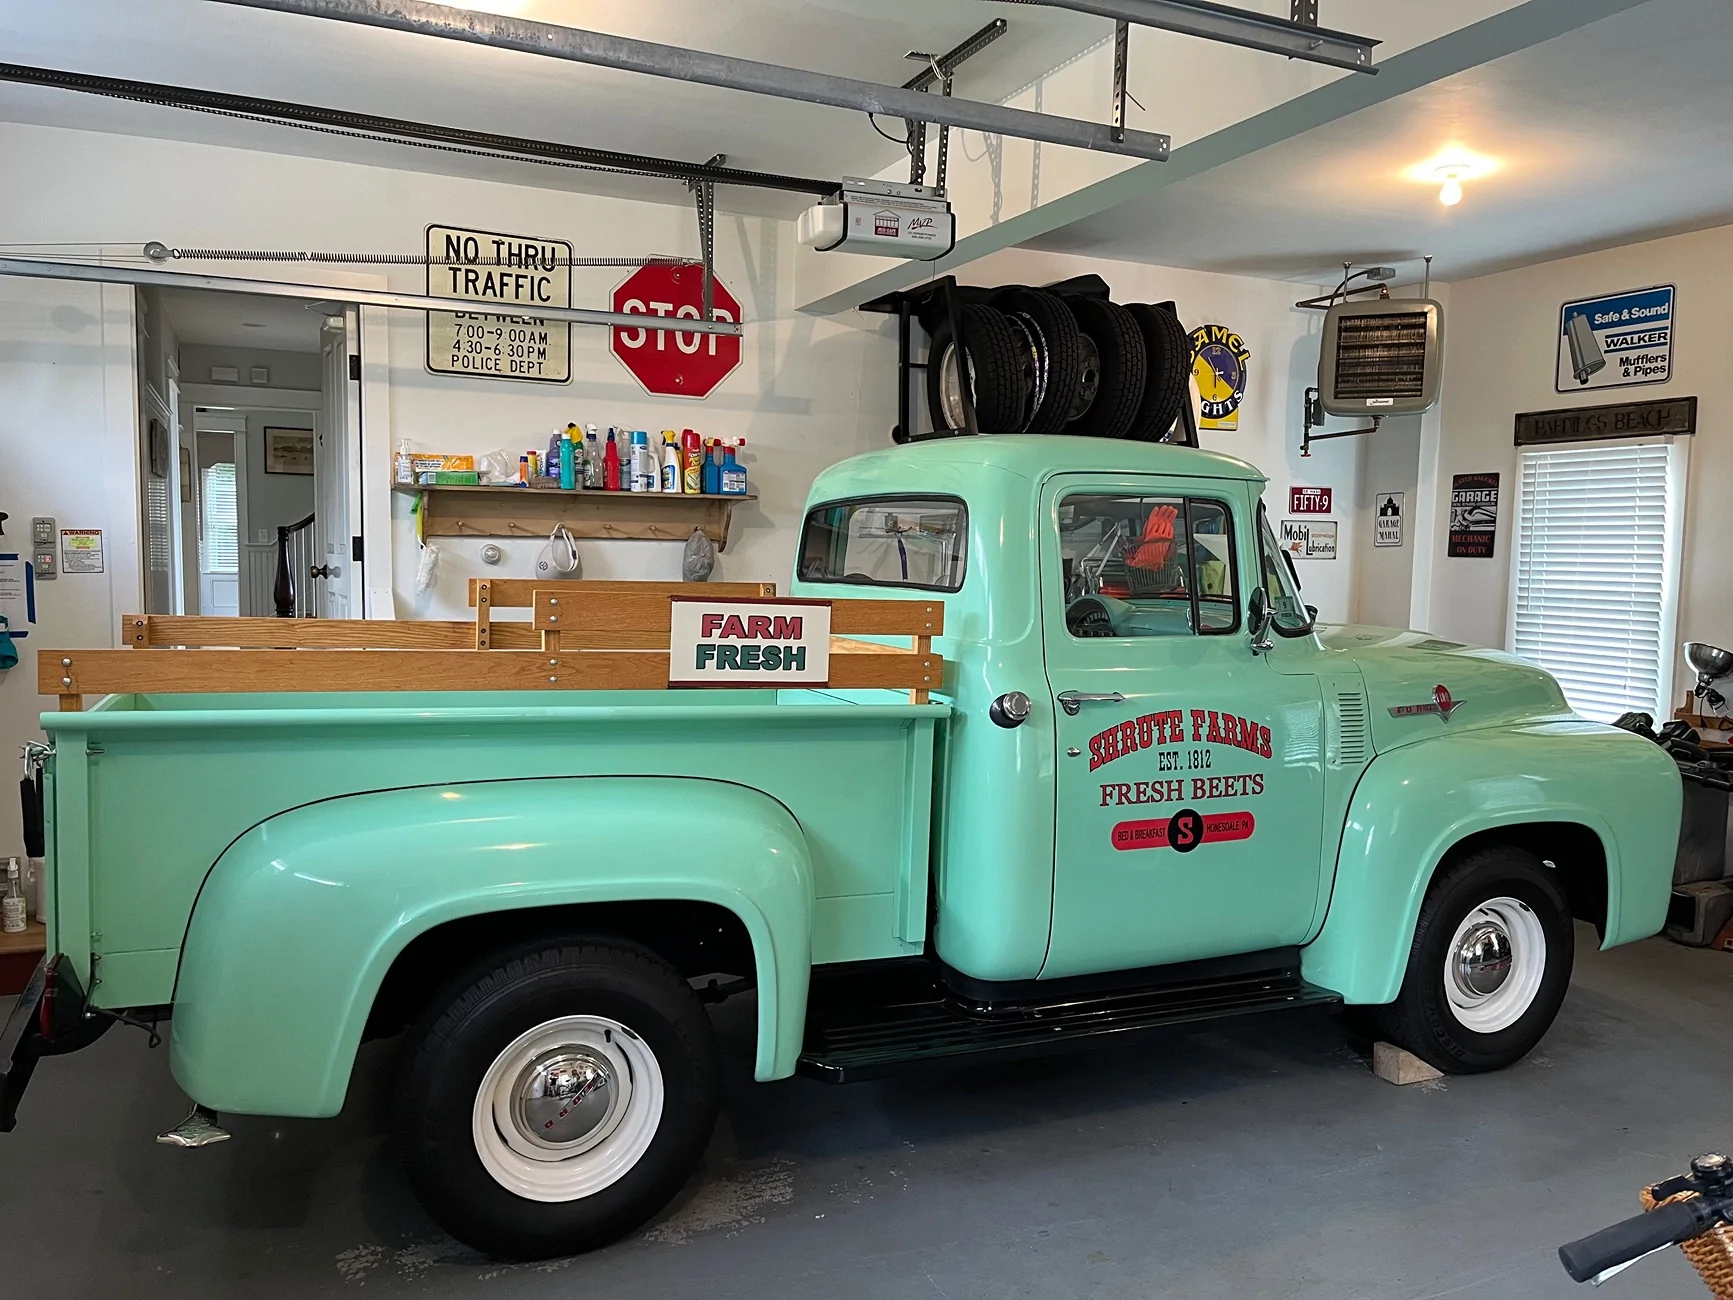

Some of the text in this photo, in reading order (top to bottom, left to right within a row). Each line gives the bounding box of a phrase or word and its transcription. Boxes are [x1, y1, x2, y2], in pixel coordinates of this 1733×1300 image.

[445, 234, 556, 272] NO THRU
[448, 268, 552, 303] TRAFFIC
[1594, 303, 1668, 325] Safe & Sound
[620, 298, 733, 356] STOP
[1605, 332, 1668, 349] WALKER
[451, 354, 501, 372] POLICE
[1619, 353, 1667, 368] Mufflers
[1622, 364, 1667, 378] & Pipes
[1201, 390, 1243, 415] GHTS
[1614, 408, 1671, 431] BEACH
[1294, 495, 1329, 511] FIFTY-9
[1452, 491, 1498, 502] GARAGE
[1378, 519, 1400, 529] GARAGE
[1378, 531, 1399, 541] MAHAL
[1452, 534, 1491, 543] MECHANIC
[1456, 546, 1487, 554] ON DUTY
[701, 614, 803, 640] FARM
[696, 644, 806, 671] FRESH
[1089, 709, 1273, 773] SHRUTE FARMS
[1158, 749, 1212, 771] EST. 1812
[1100, 773, 1264, 807] FRESH BEETS
[1117, 827, 1166, 841] BED & BREAKFAST
[1177, 816, 1194, 845] S
[1206, 819, 1249, 833] HONESDALE PA
